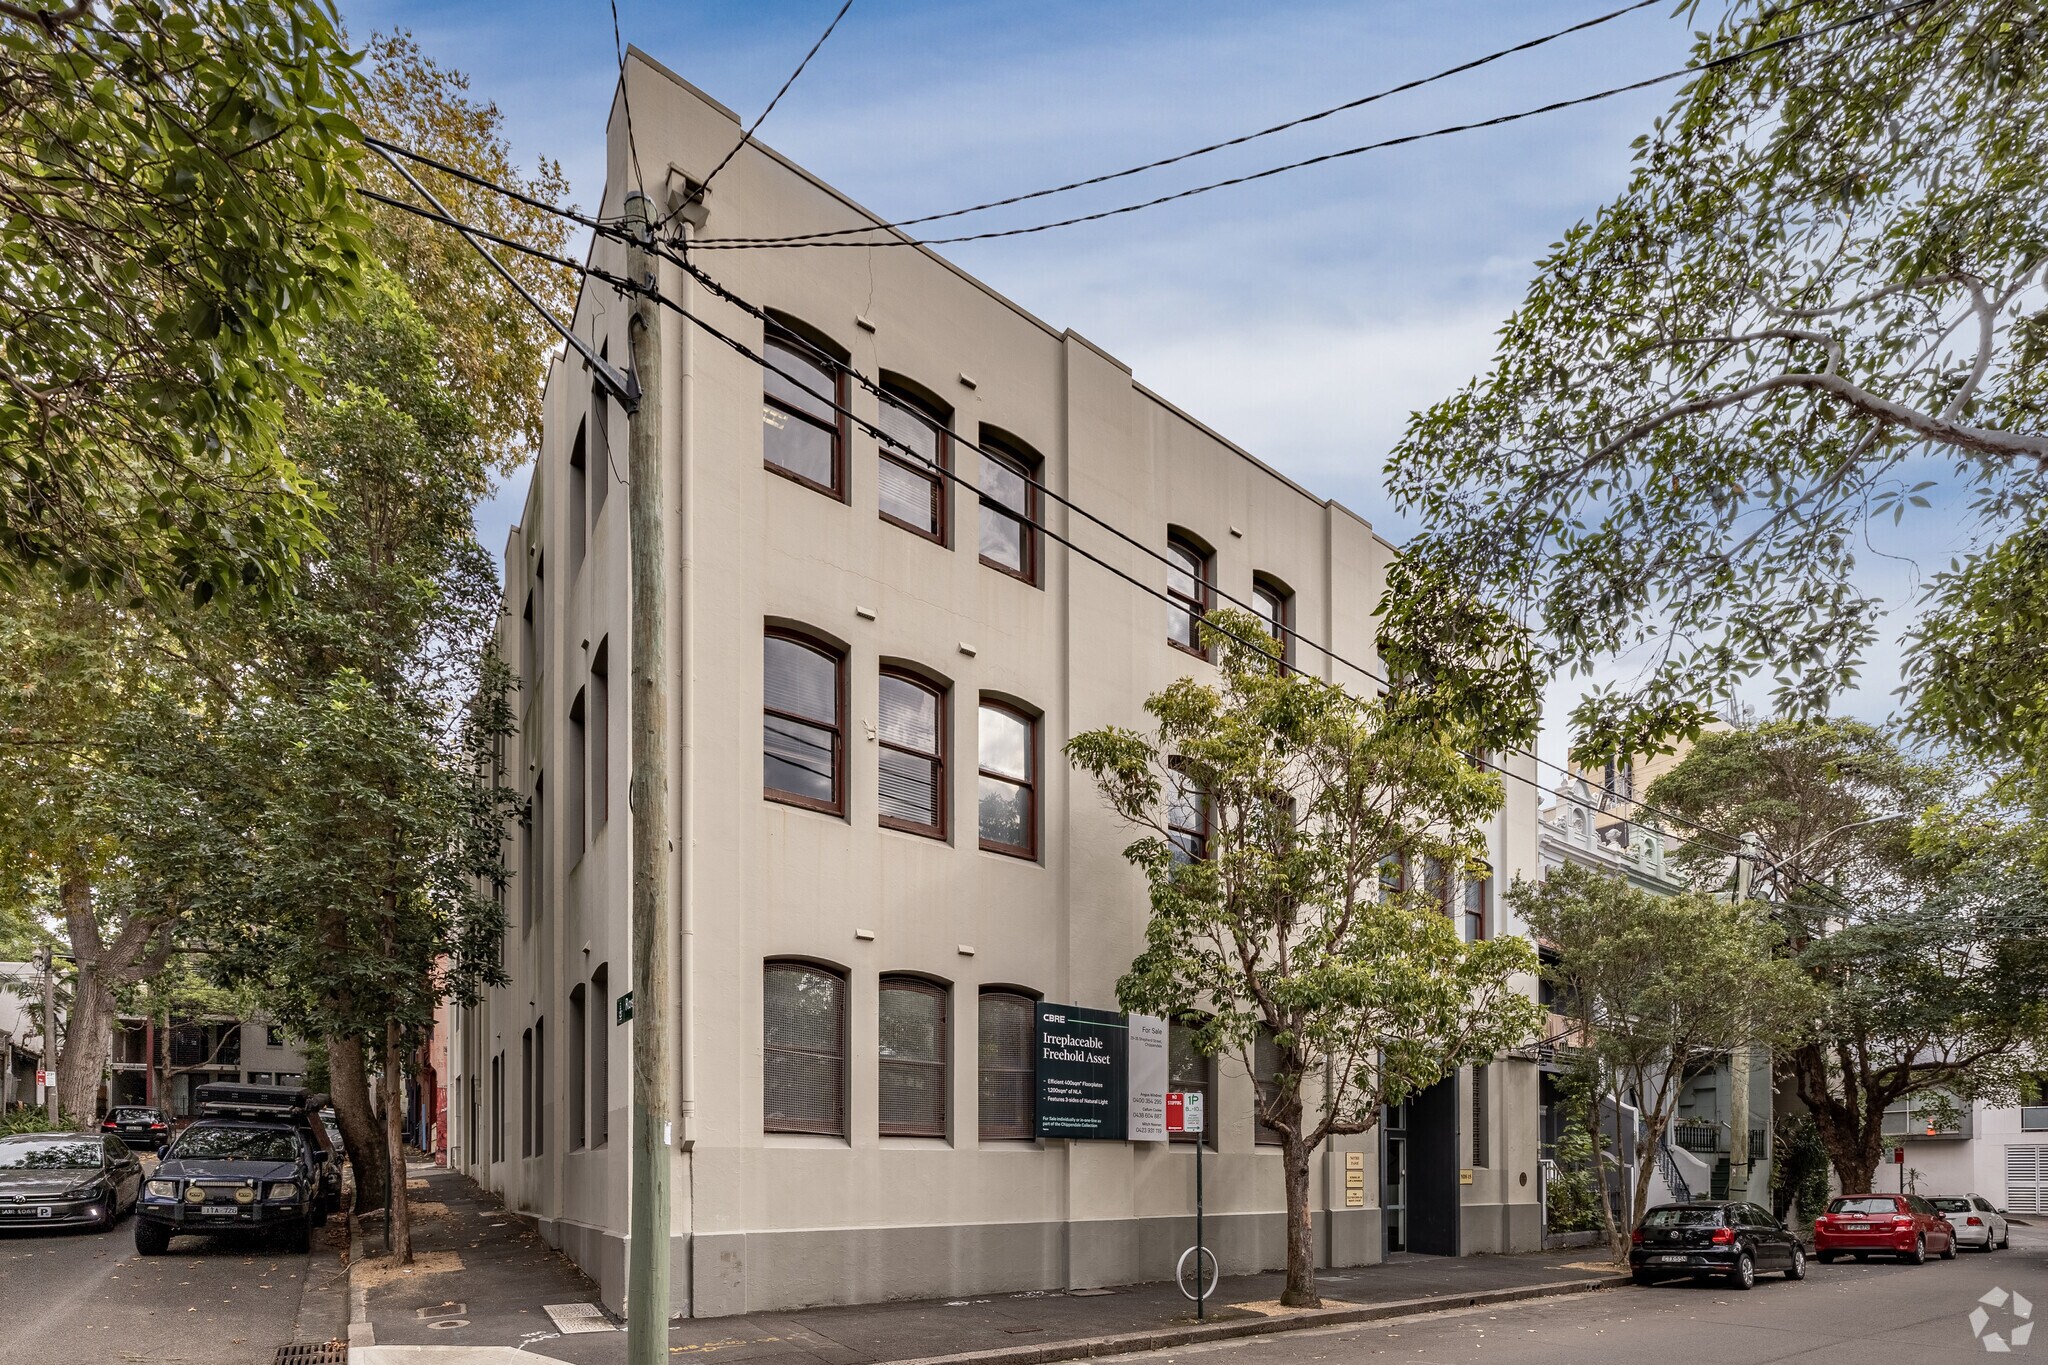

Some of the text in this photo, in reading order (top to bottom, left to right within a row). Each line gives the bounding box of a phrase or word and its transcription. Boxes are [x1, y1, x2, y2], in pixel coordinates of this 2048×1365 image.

[1043, 1014, 1065, 1024] CBRE
[1142, 1026, 1162, 1035] For Sale
[1043, 1032, 1103, 1049] Irreplaceable
[1043, 1048, 1110, 1064] Freehold Asset
[1188, 1094, 1199, 1105] 1P
